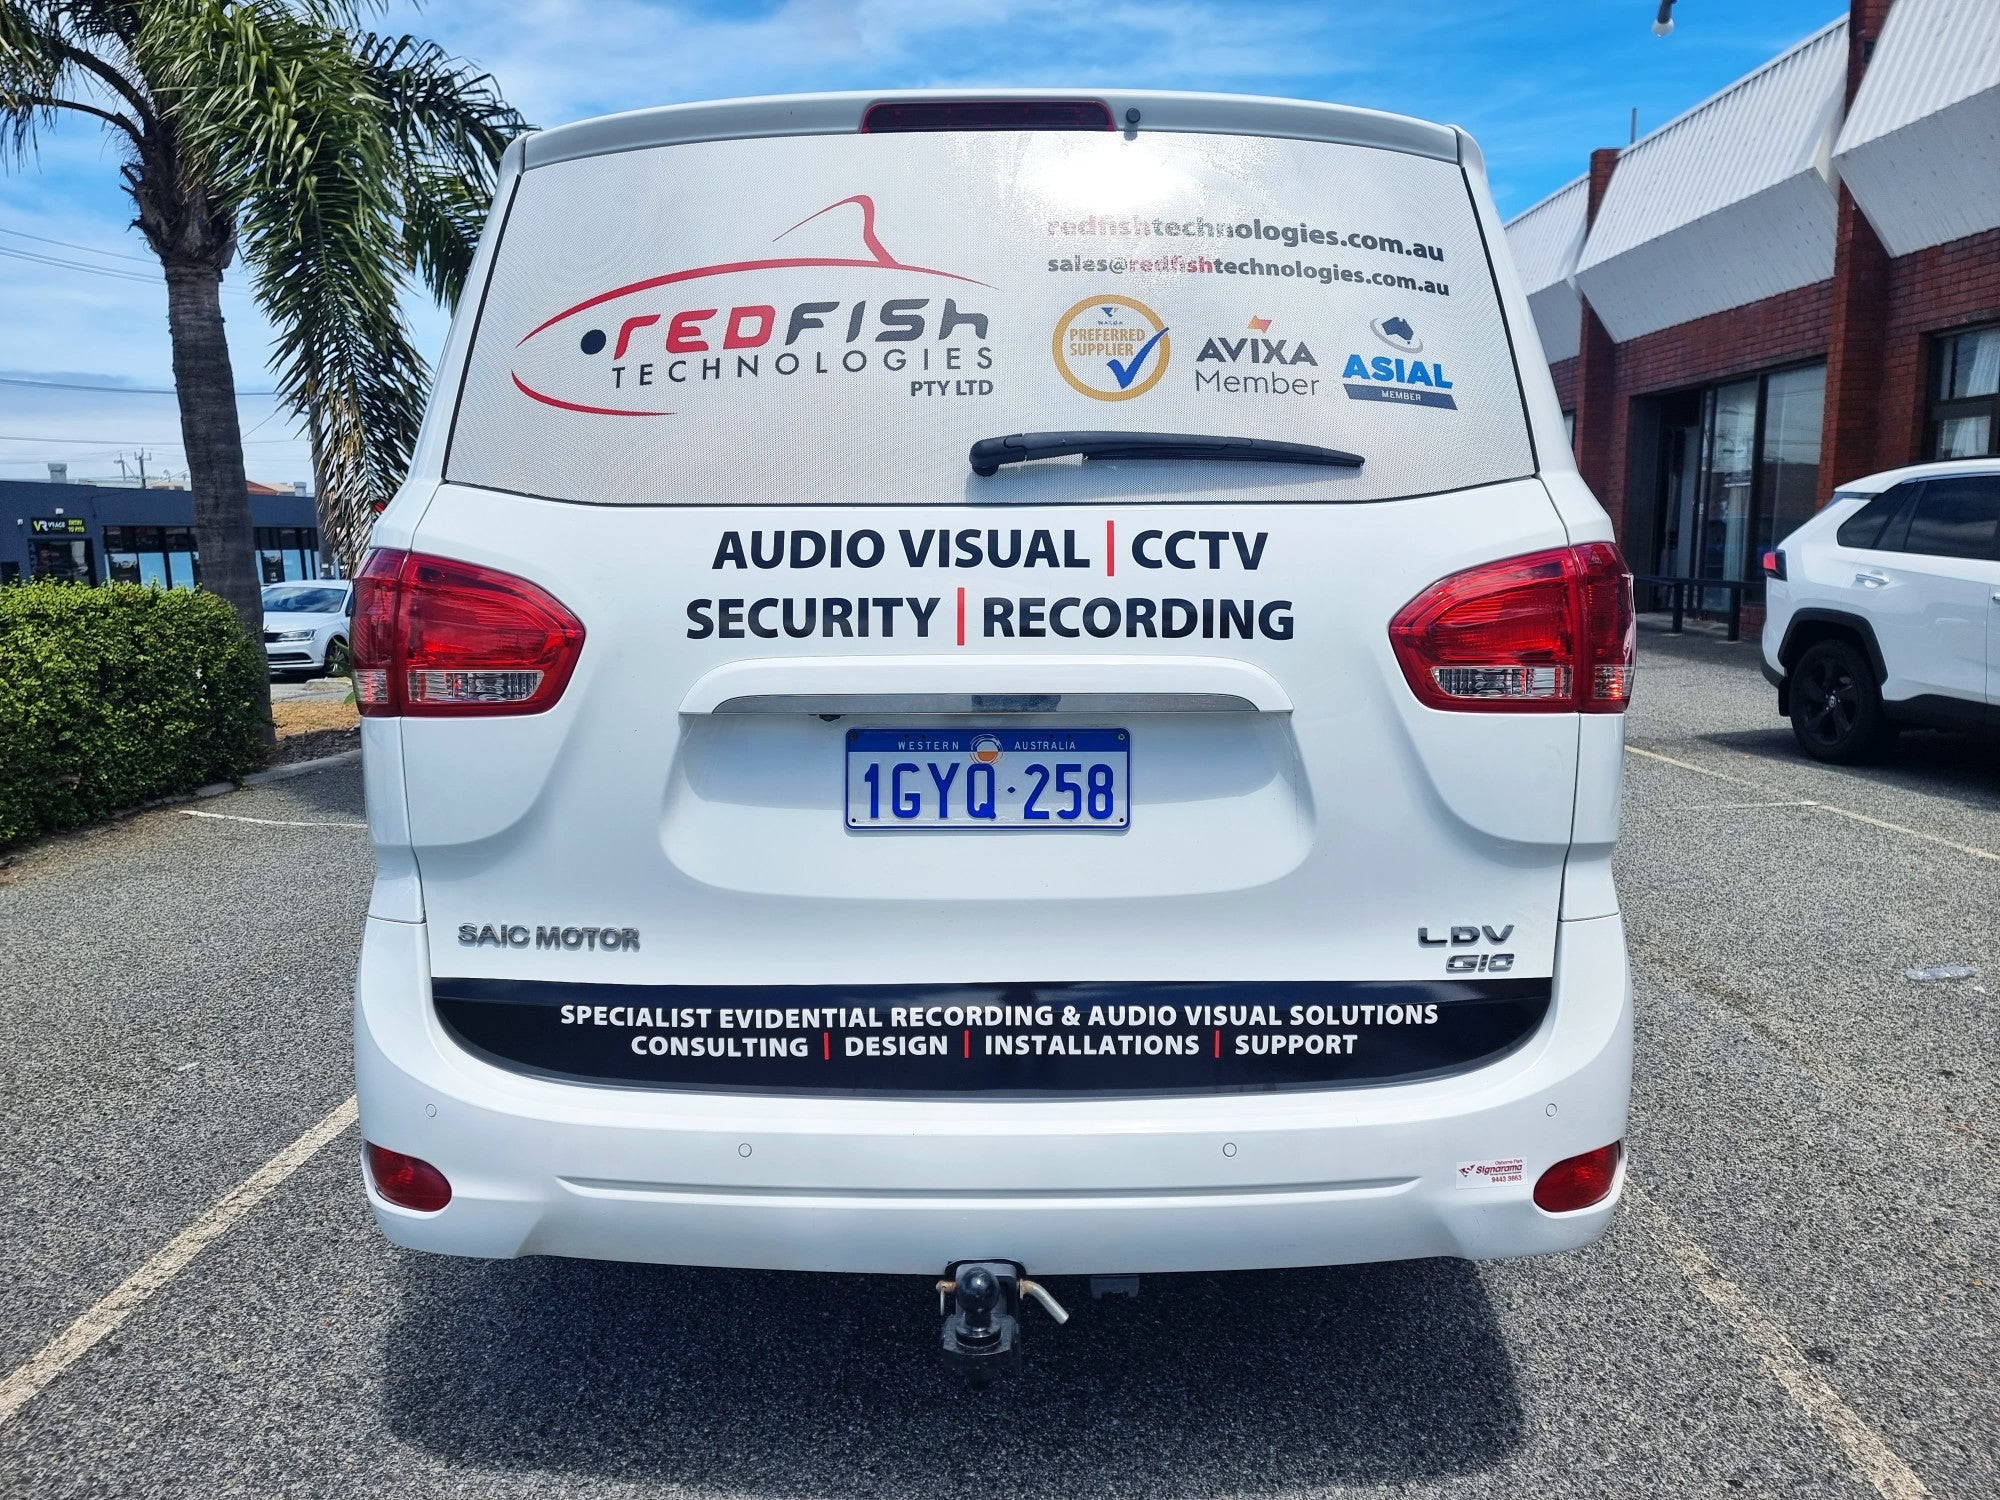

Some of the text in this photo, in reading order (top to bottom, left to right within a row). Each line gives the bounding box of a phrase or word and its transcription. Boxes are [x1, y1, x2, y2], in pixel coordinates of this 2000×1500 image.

[1047, 254, 1450, 296] sales@redfishtechnologies.com.au
[1069, 328, 1146, 341] PREFERRED
[1070, 343, 1134, 356] SUPPLIER
[1196, 337, 1319, 366] AVIXA
[612, 347, 993, 388] TECHNOLOGIES
[1342, 354, 1453, 389] ASIAL
[910, 379, 994, 397] PTY LTD
[1195, 369, 1320, 395] Member
[1381, 390, 1422, 401] MEMBER
[712, 529, 1268, 570] AUDIO VISUAL CCTV
[686, 597, 1294, 640] SECURITY RECORDING
[898, 741, 1076, 750] WESTERN AUSTRALIA
[458, 923, 641, 951] SAIC MOTOR
[1418, 924, 1515, 947] LDV
[561, 1004, 1438, 1028] SPECIALIST EVIDENTIAL RECORDING & AUDIO VISUAL SOLUTIONS
[631, 1034, 1358, 1057] CONSULTING DESIGN INSTALLATIONS SUPPORT
[1476, 1164, 1523, 1175] Signarama
